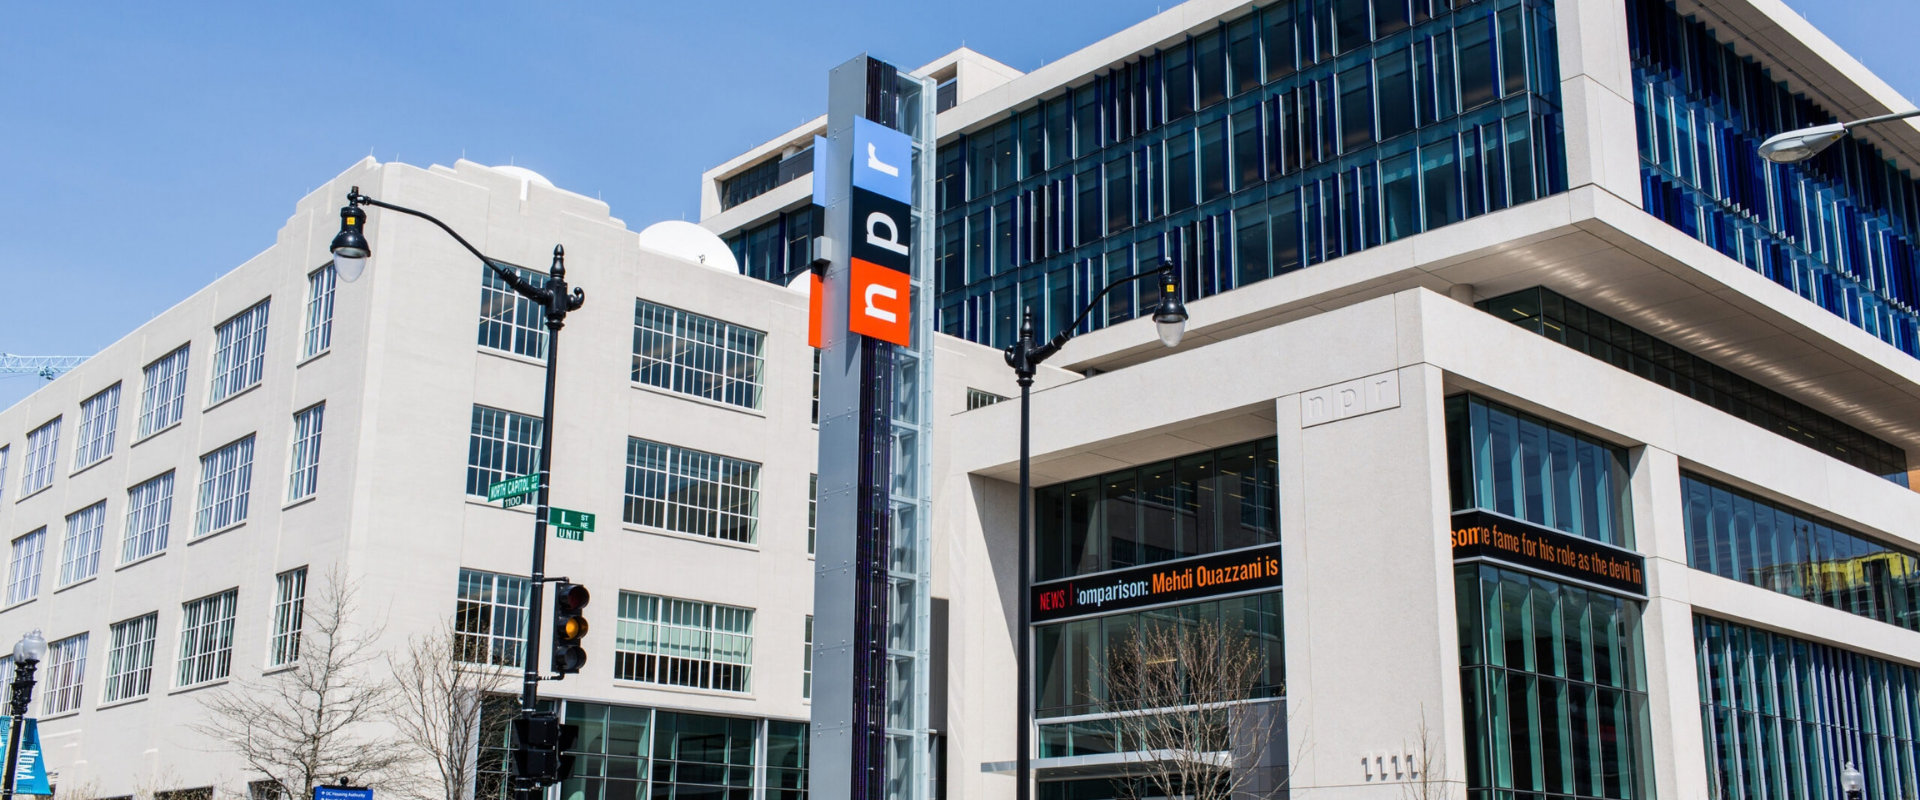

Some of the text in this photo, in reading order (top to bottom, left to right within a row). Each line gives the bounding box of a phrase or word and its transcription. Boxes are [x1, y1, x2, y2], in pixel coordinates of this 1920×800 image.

[865, 142, 908, 323] npr
[1309, 380, 1387, 418] npr
[531, 475, 538, 483] ST
[531, 482, 538, 490] NE
[490, 477, 530, 499] NORTH CAPITOL
[505, 495, 521, 507] 1100
[561, 511, 571, 525] L
[580, 514, 589, 522] ST
[580, 521, 589, 529] NE
[559, 529, 580, 540] UNIT
[1492, 523, 1520, 553] fame
[1521, 532, 1537, 558] for
[1538, 536, 1555, 563] his
[1556, 544, 1576, 568] role
[1578, 553, 1590, 571] as
[1591, 552, 1608, 576] the
[1609, 556, 1631, 582] devil
[1632, 562, 1642, 585] in
[1039, 589, 1065, 612] NEWS
[1152, 568, 1193, 595] Mehdi
[1197, 557, 1261, 587] Ouazzani
[1265, 555, 1279, 577] is
[1361, 750, 1419, 782] 1111
